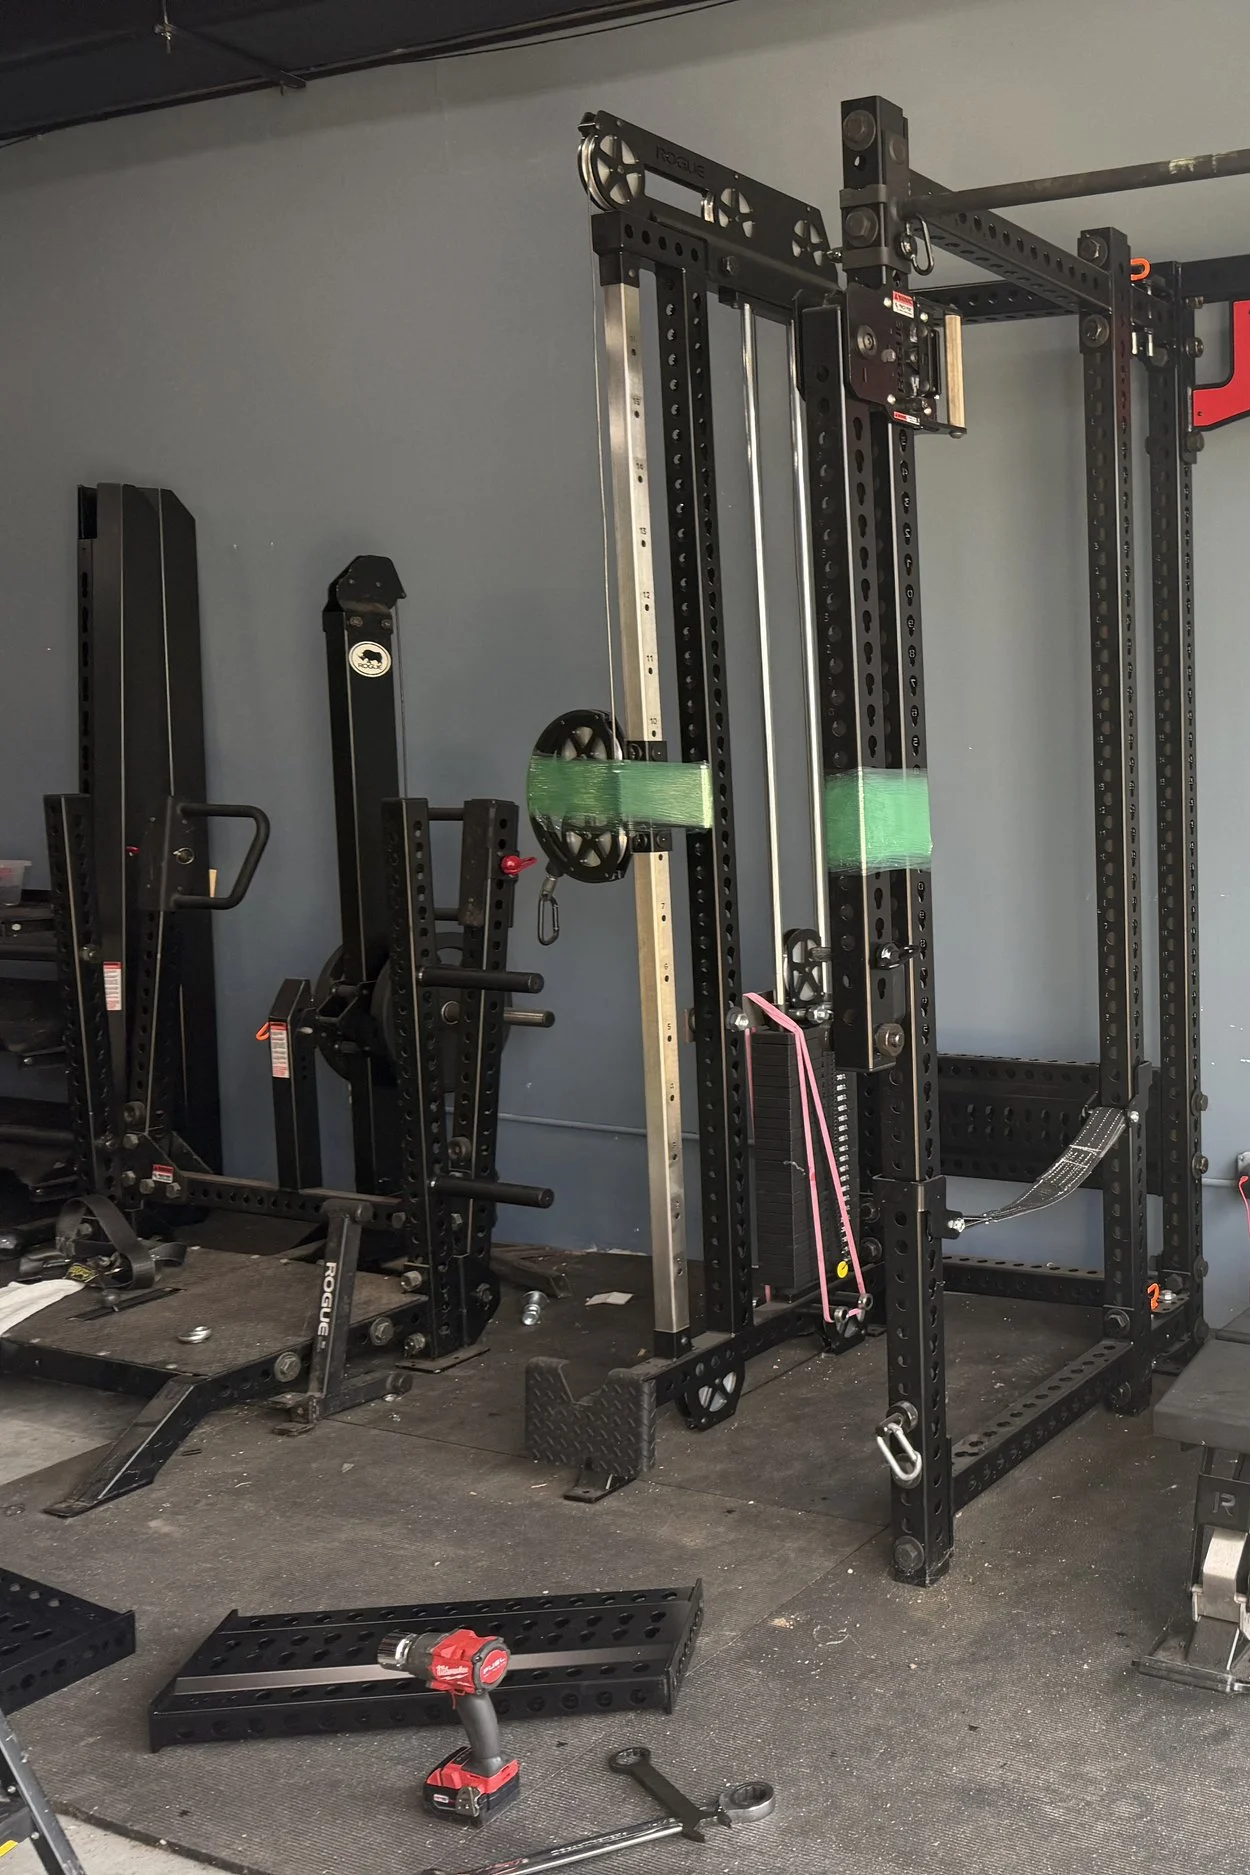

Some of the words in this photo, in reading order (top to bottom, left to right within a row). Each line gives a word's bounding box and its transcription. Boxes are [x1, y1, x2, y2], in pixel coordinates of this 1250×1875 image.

[656, 143, 705, 179] ROGUE
[318, 1262, 337, 1336] ROGUE
[1212, 1490, 1236, 1517] R
[483, 1657, 505, 1674] FUEL
